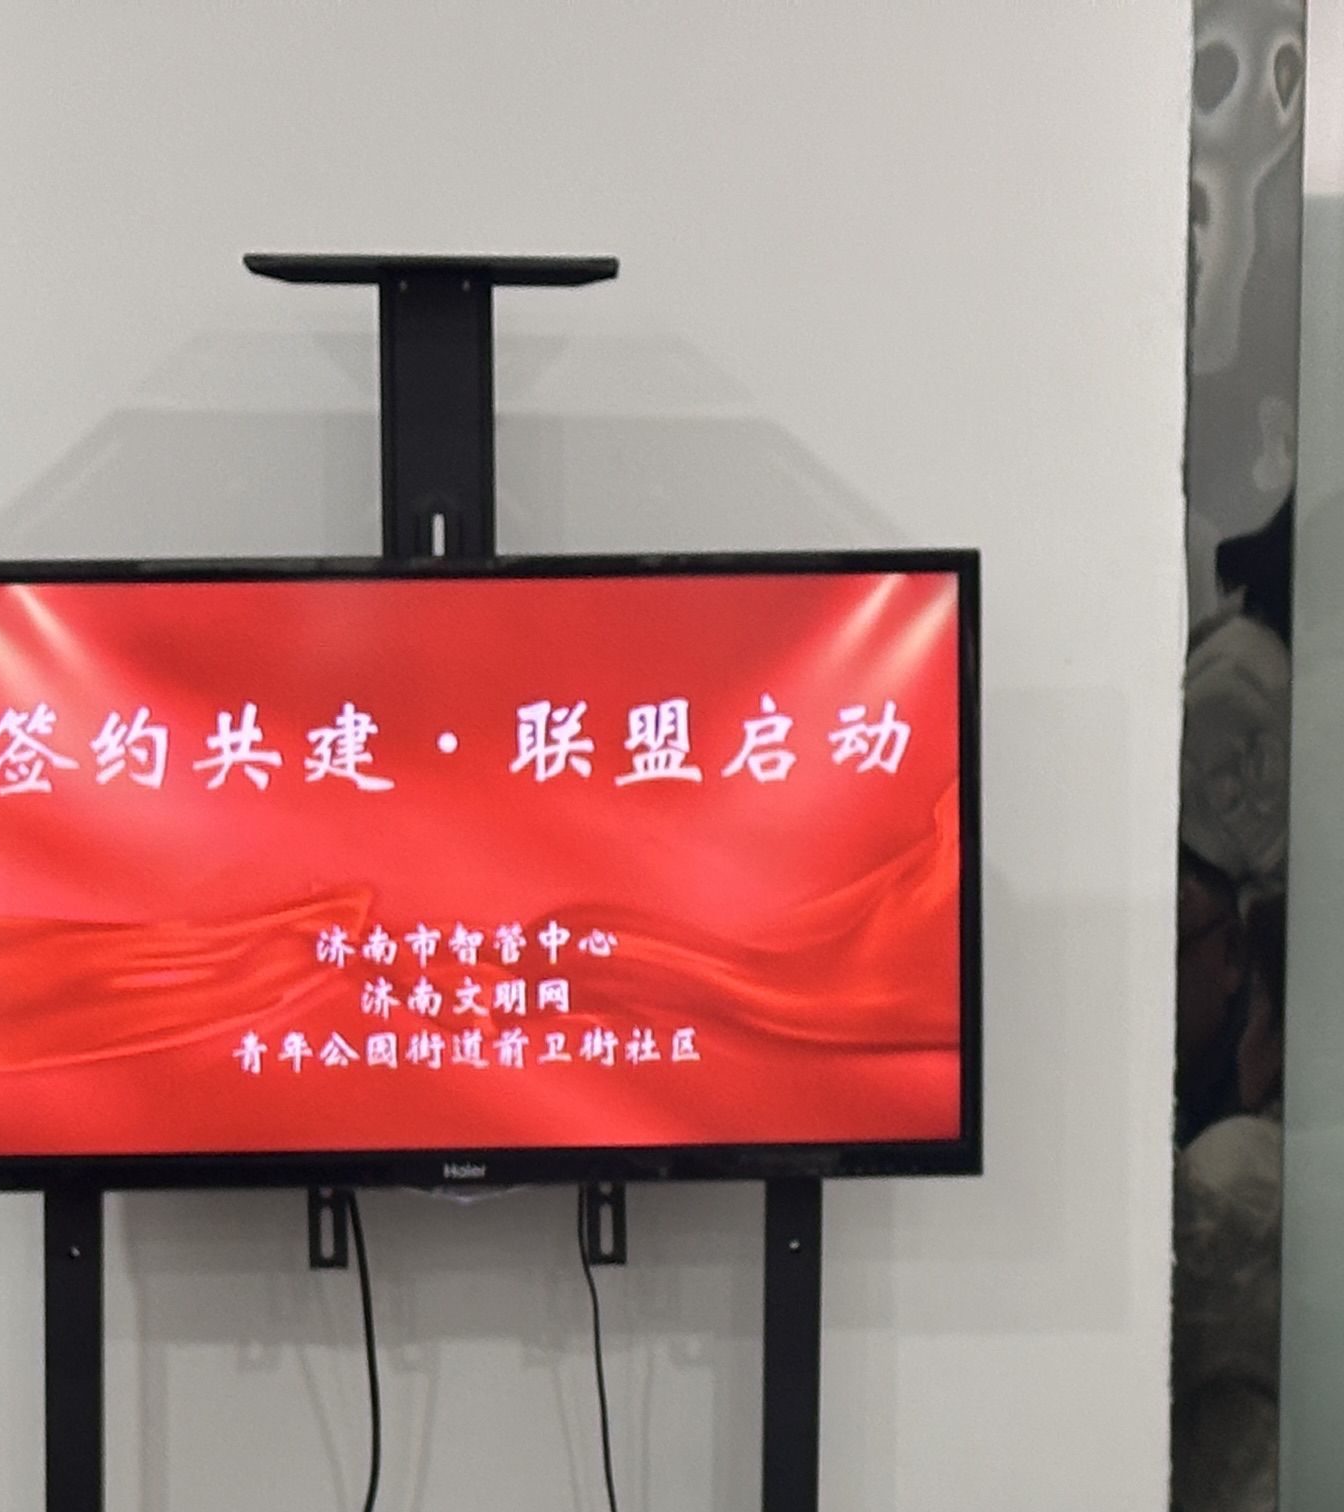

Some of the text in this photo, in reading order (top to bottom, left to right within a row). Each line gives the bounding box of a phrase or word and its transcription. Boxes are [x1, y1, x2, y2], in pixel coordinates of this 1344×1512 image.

[315, 919, 619, 969] 济南市智管中心
[360, 975, 572, 1021] 济南文明网
[232, 1026, 702, 1076] 青年公园街道前卫街社区
